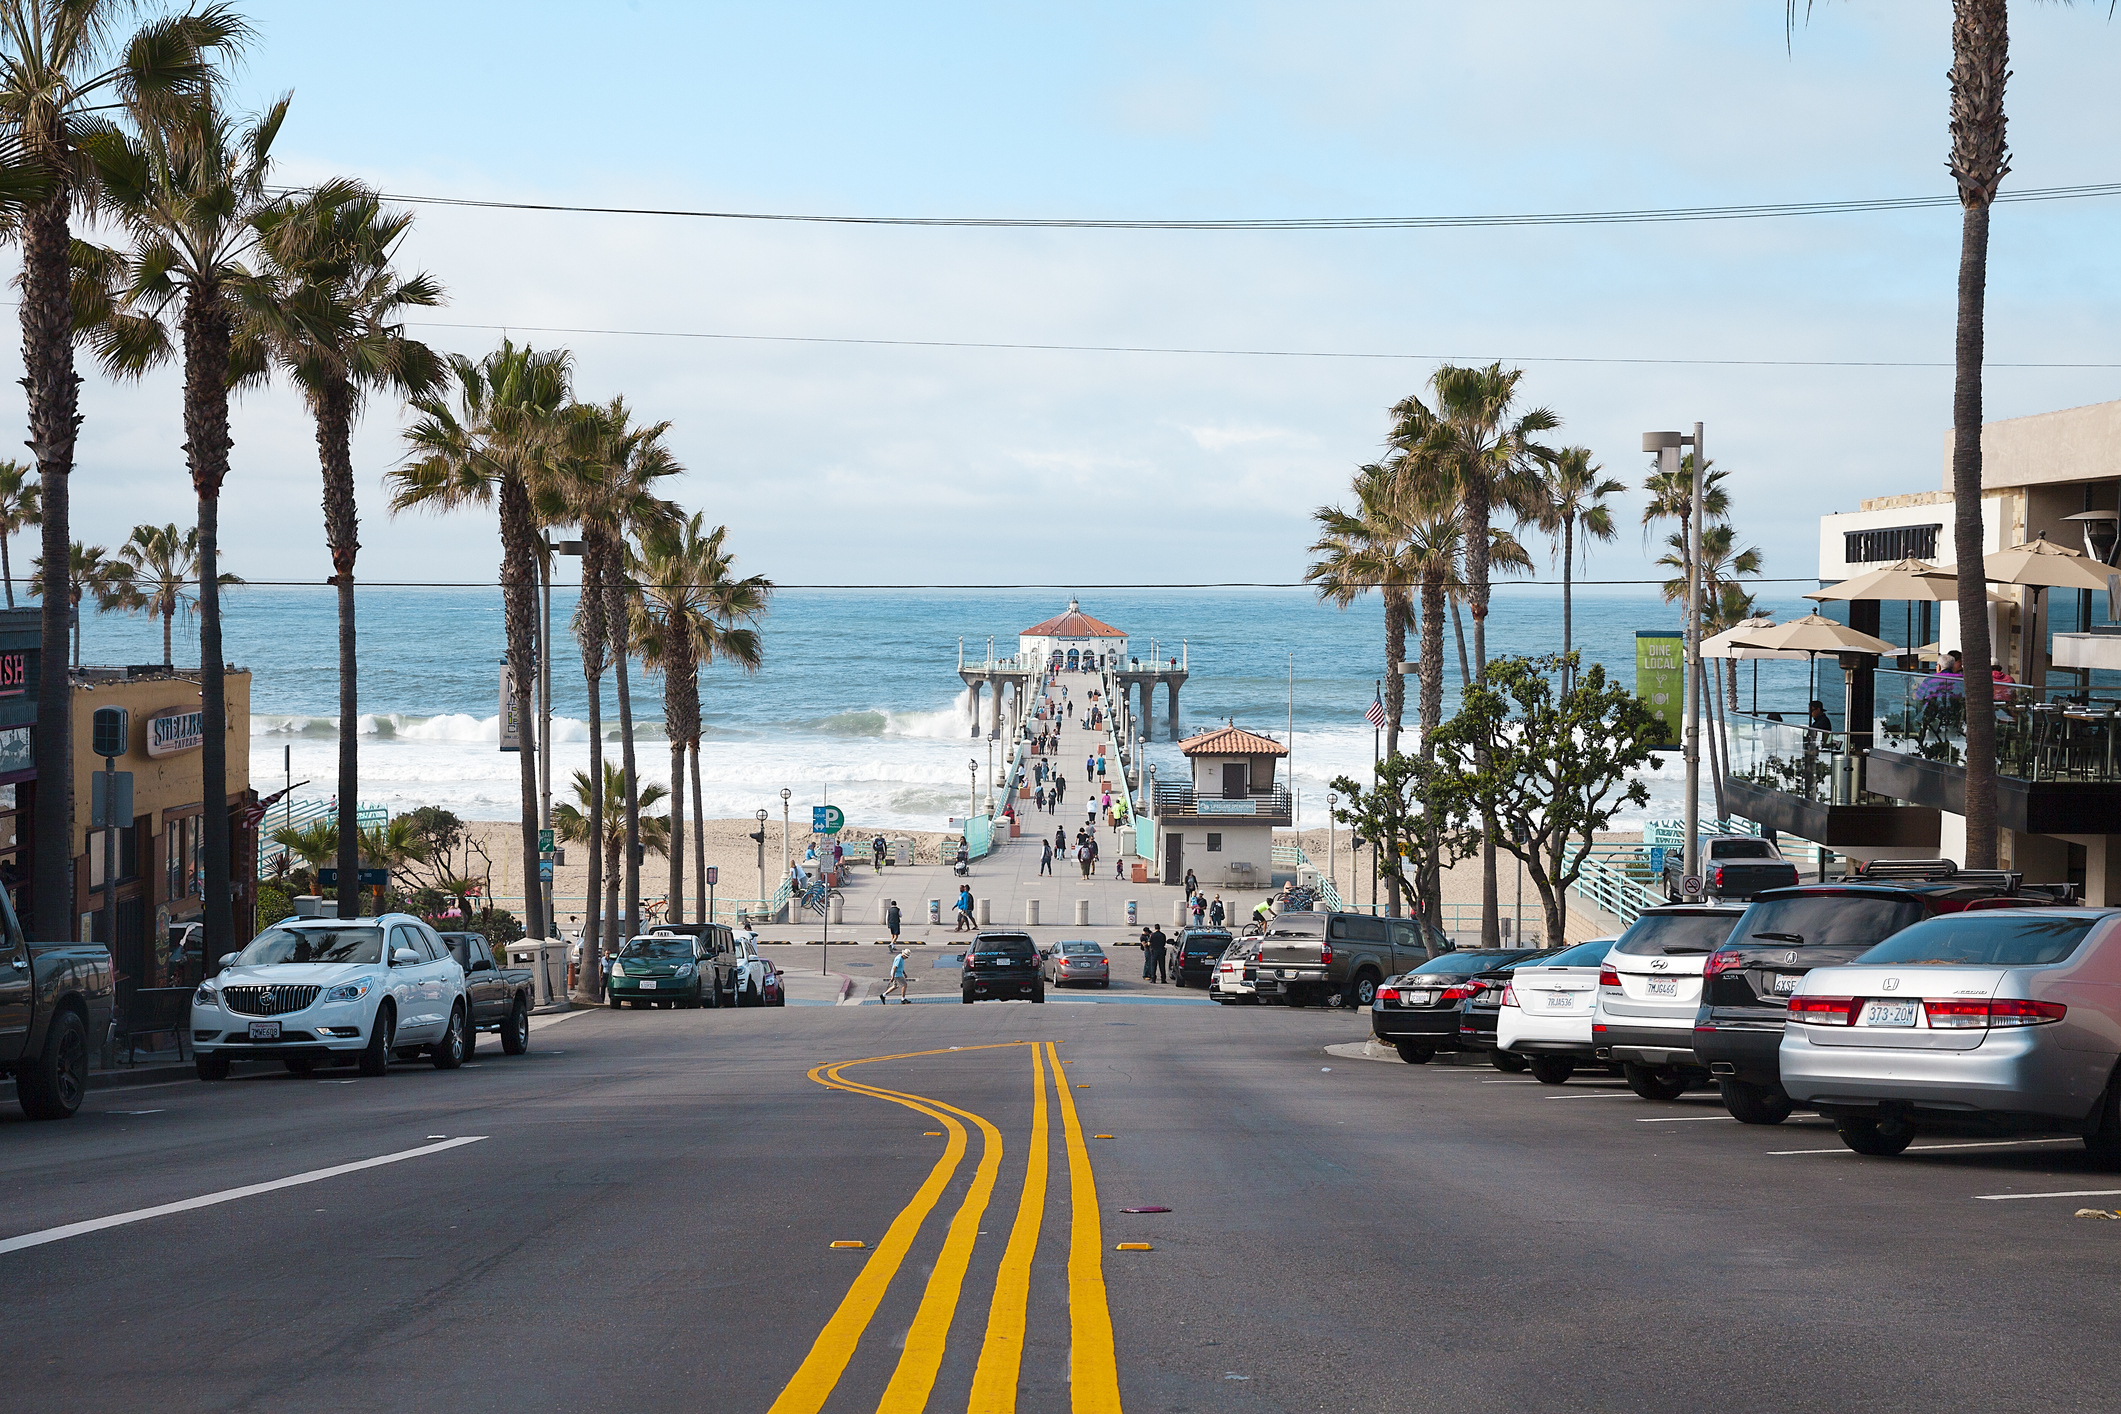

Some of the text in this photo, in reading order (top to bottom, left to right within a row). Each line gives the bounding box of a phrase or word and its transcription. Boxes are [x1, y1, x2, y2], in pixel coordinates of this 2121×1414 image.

[1649, 644, 1671, 656] DINE
[1644, 657, 1676, 669] LOCAL
[154, 712, 203, 746] SHELLBA
